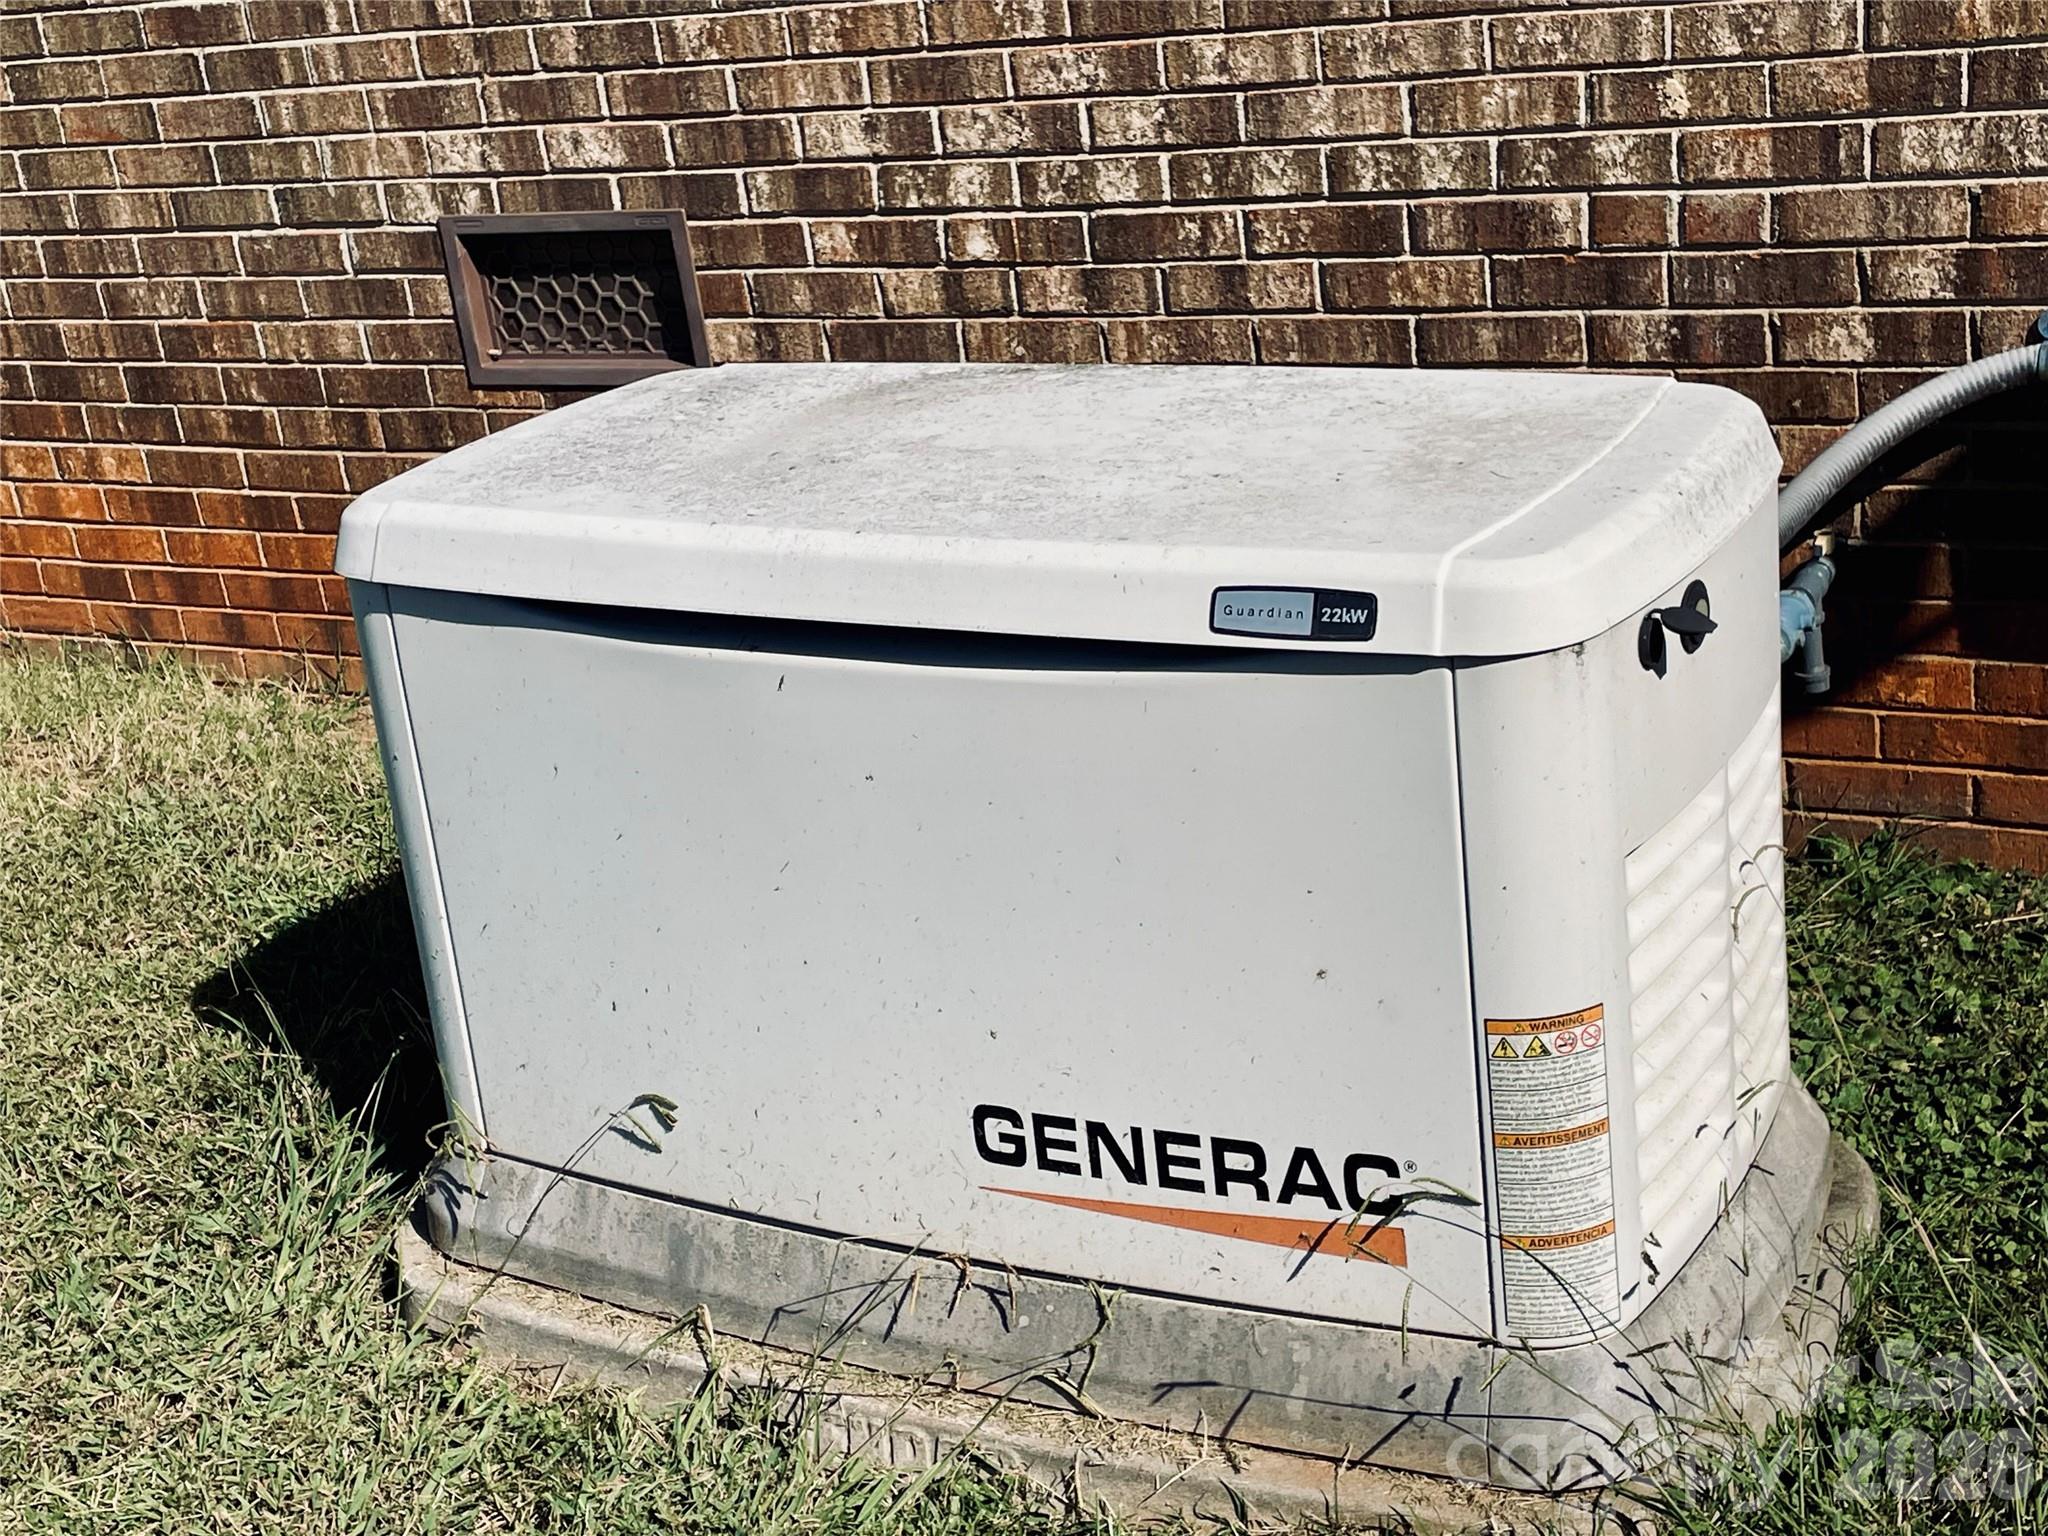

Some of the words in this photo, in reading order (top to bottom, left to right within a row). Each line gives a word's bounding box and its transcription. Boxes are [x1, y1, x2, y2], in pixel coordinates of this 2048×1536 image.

[1223, 604, 1304, 620] Guardian
[1321, 607, 1369, 624] 22kW
[1529, 1014, 1585, 1032] WARNING
[1513, 1121, 1607, 1146] AVERTISSEMENT
[1528, 1226, 1608, 1248] ADVERTENCIA
